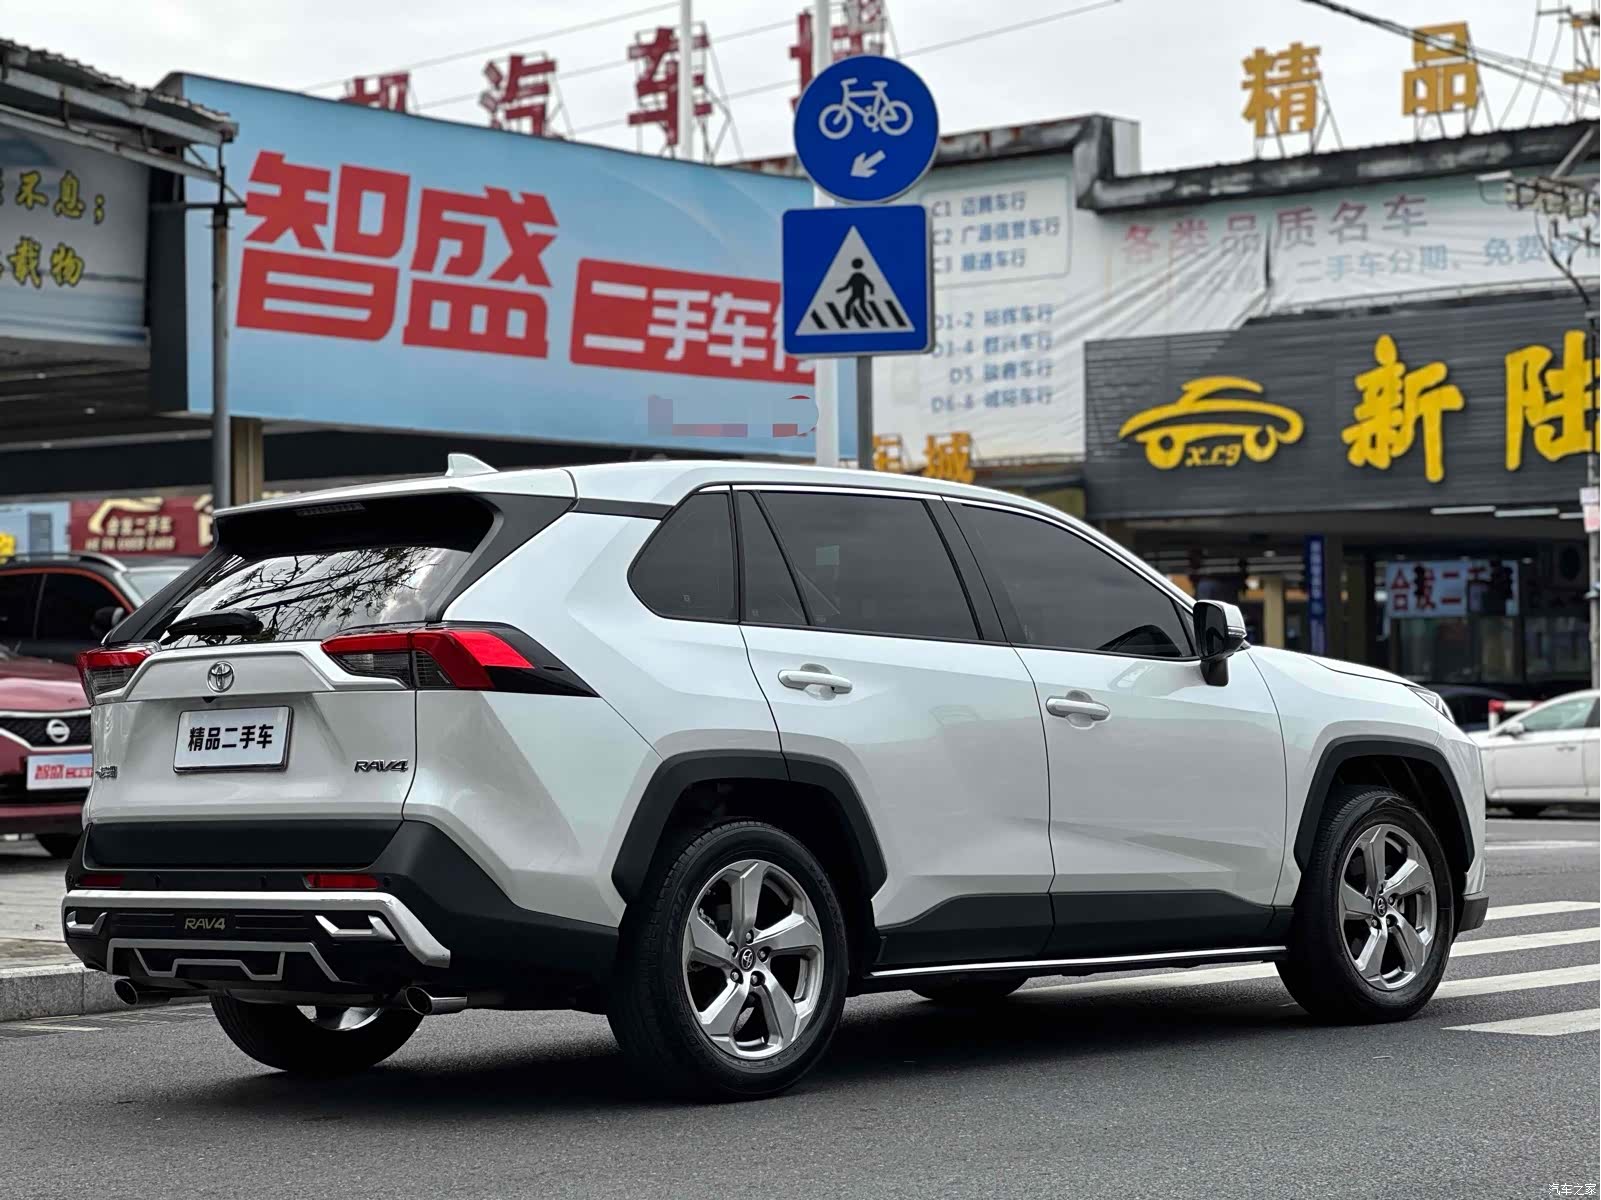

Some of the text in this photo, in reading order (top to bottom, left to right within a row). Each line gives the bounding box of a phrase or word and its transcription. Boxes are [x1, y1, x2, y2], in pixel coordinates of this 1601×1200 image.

[0, 169, 105, 225] 不息；
[236, 151, 559, 358] 智盛
[1125, 194, 1429, 263] 各类品质名车
[0, 236, 85, 288] 载物
[188, 724, 274, 752] 精品二手车
[354, 759, 409, 773] RAV4
[184, 917, 226, 931] RAV4
